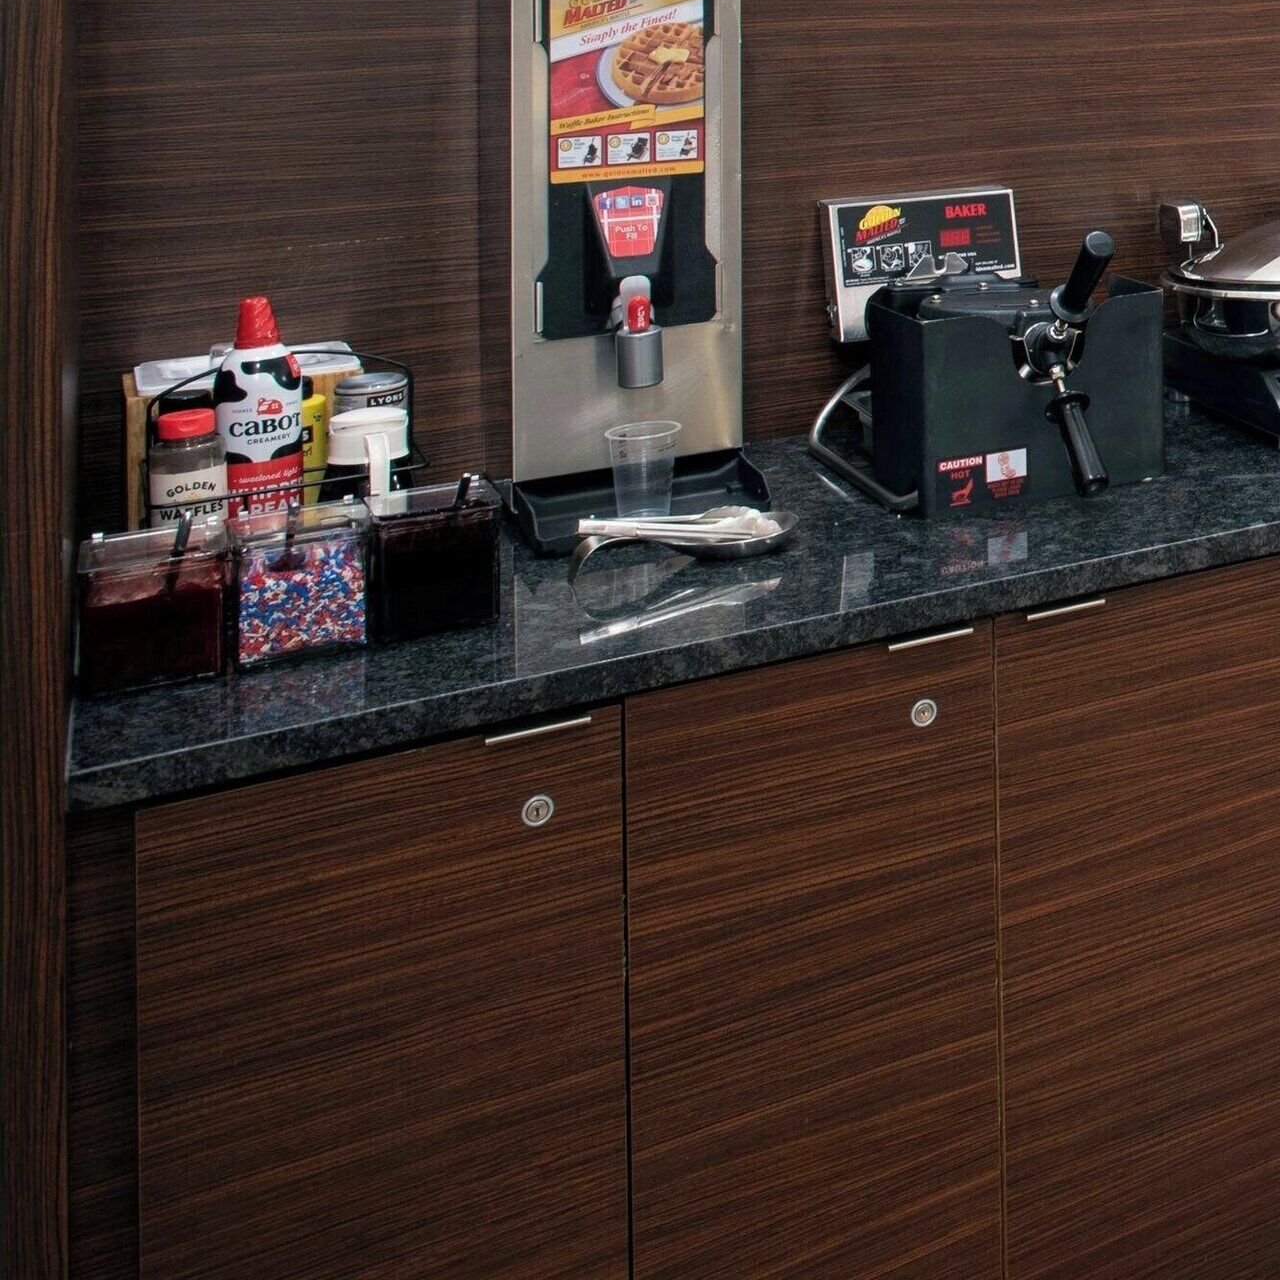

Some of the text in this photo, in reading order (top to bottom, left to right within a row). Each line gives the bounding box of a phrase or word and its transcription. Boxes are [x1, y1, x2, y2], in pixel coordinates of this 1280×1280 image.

[579, 8, 678, 46] Simply the Finest!
[945, 202, 987, 219] BAKER
[855, 217, 898, 244] MALTED
[371, 392, 403, 406] LYONS
[247, 433, 290, 445] CREAMERY
[940, 456, 983, 471] CAUTION
[239, 471, 281, 484] sweetened
[951, 469, 971, 480] HOT
[166, 482, 216, 497] GOLDEN
